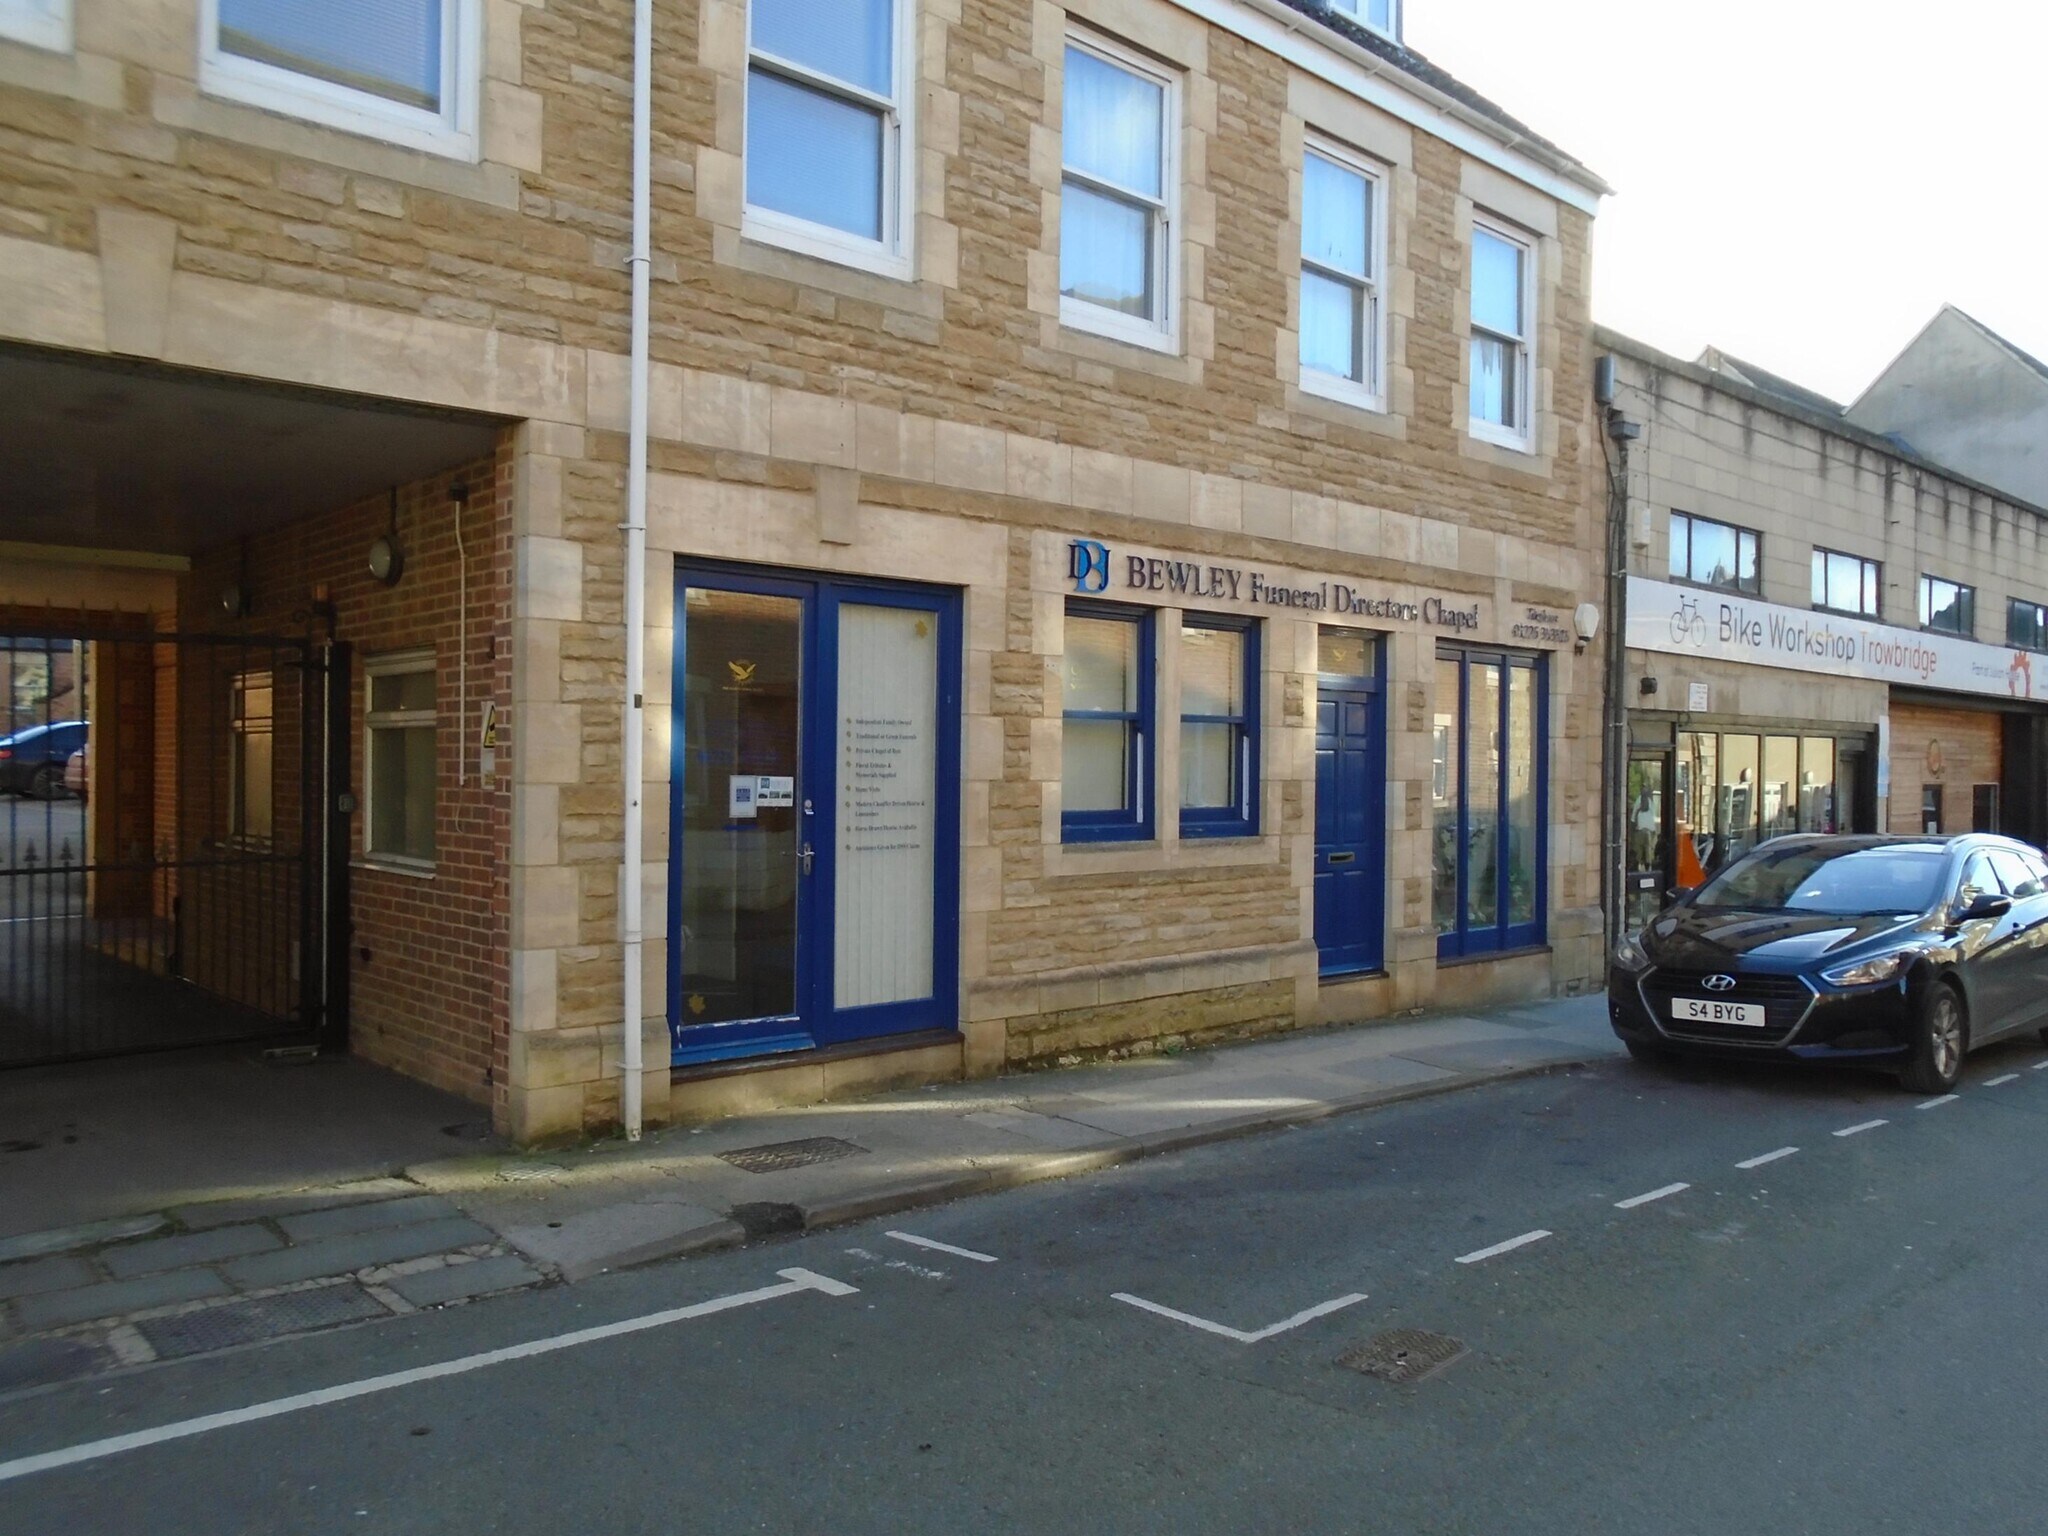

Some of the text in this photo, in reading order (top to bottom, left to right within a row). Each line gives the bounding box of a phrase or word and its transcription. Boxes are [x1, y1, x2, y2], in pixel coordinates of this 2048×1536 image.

[1126, 555, 1241, 600] BEWLEY
[1250, 572, 1327, 611] Funeral
[1334, 584, 1418, 621] Directors
[1424, 597, 1478, 633] Chapel
[1719, 604, 1937, 680] Bike Workshop Trowbridge
[1689, 1002, 1746, 1021] S4 BYG
